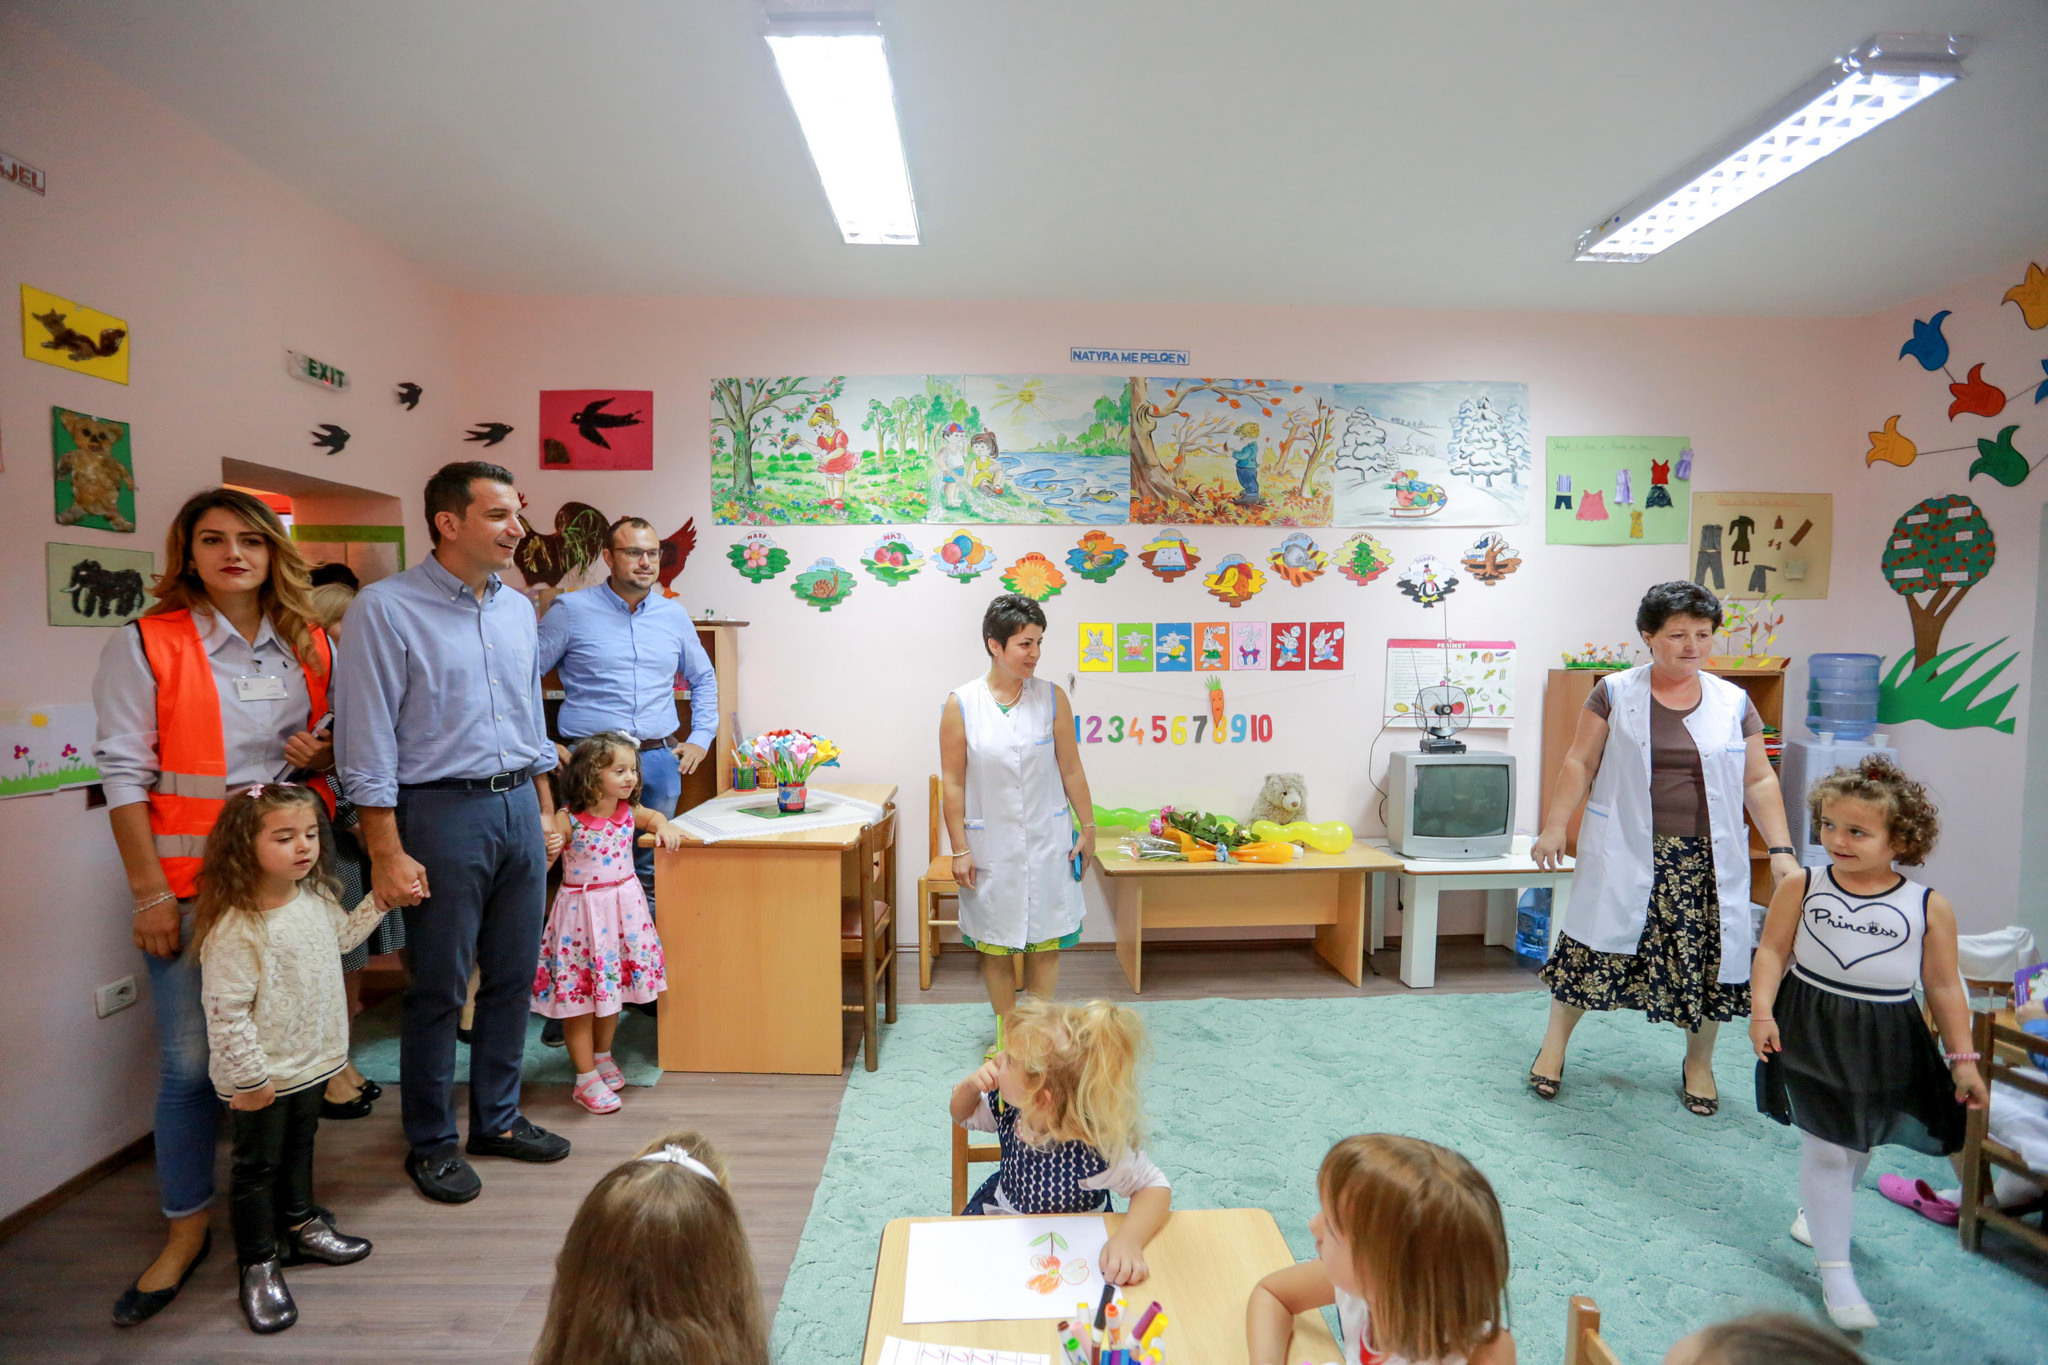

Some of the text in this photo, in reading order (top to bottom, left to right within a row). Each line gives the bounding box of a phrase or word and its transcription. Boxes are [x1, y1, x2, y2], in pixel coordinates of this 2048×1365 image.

[1072, 350, 1119, 362] NATYRA
[1121, 352, 1139, 363] ME
[308, 357, 345, 389] EXIT
[883, 532, 902, 541] MAJ
[1086, 715, 1103, 744] 2
[1107, 715, 1125, 744] 3
[1128, 716, 1145, 745] 4
[1151, 715, 1168, 744] 5
[1170, 715, 1188, 745] 6
[1192, 715, 1208, 744] 7
[1212, 714, 1228, 744] 8
[1230, 713, 1248, 744] 9
[1250, 713, 1273, 744] 10
[1809, 910, 1899, 939] Princess
